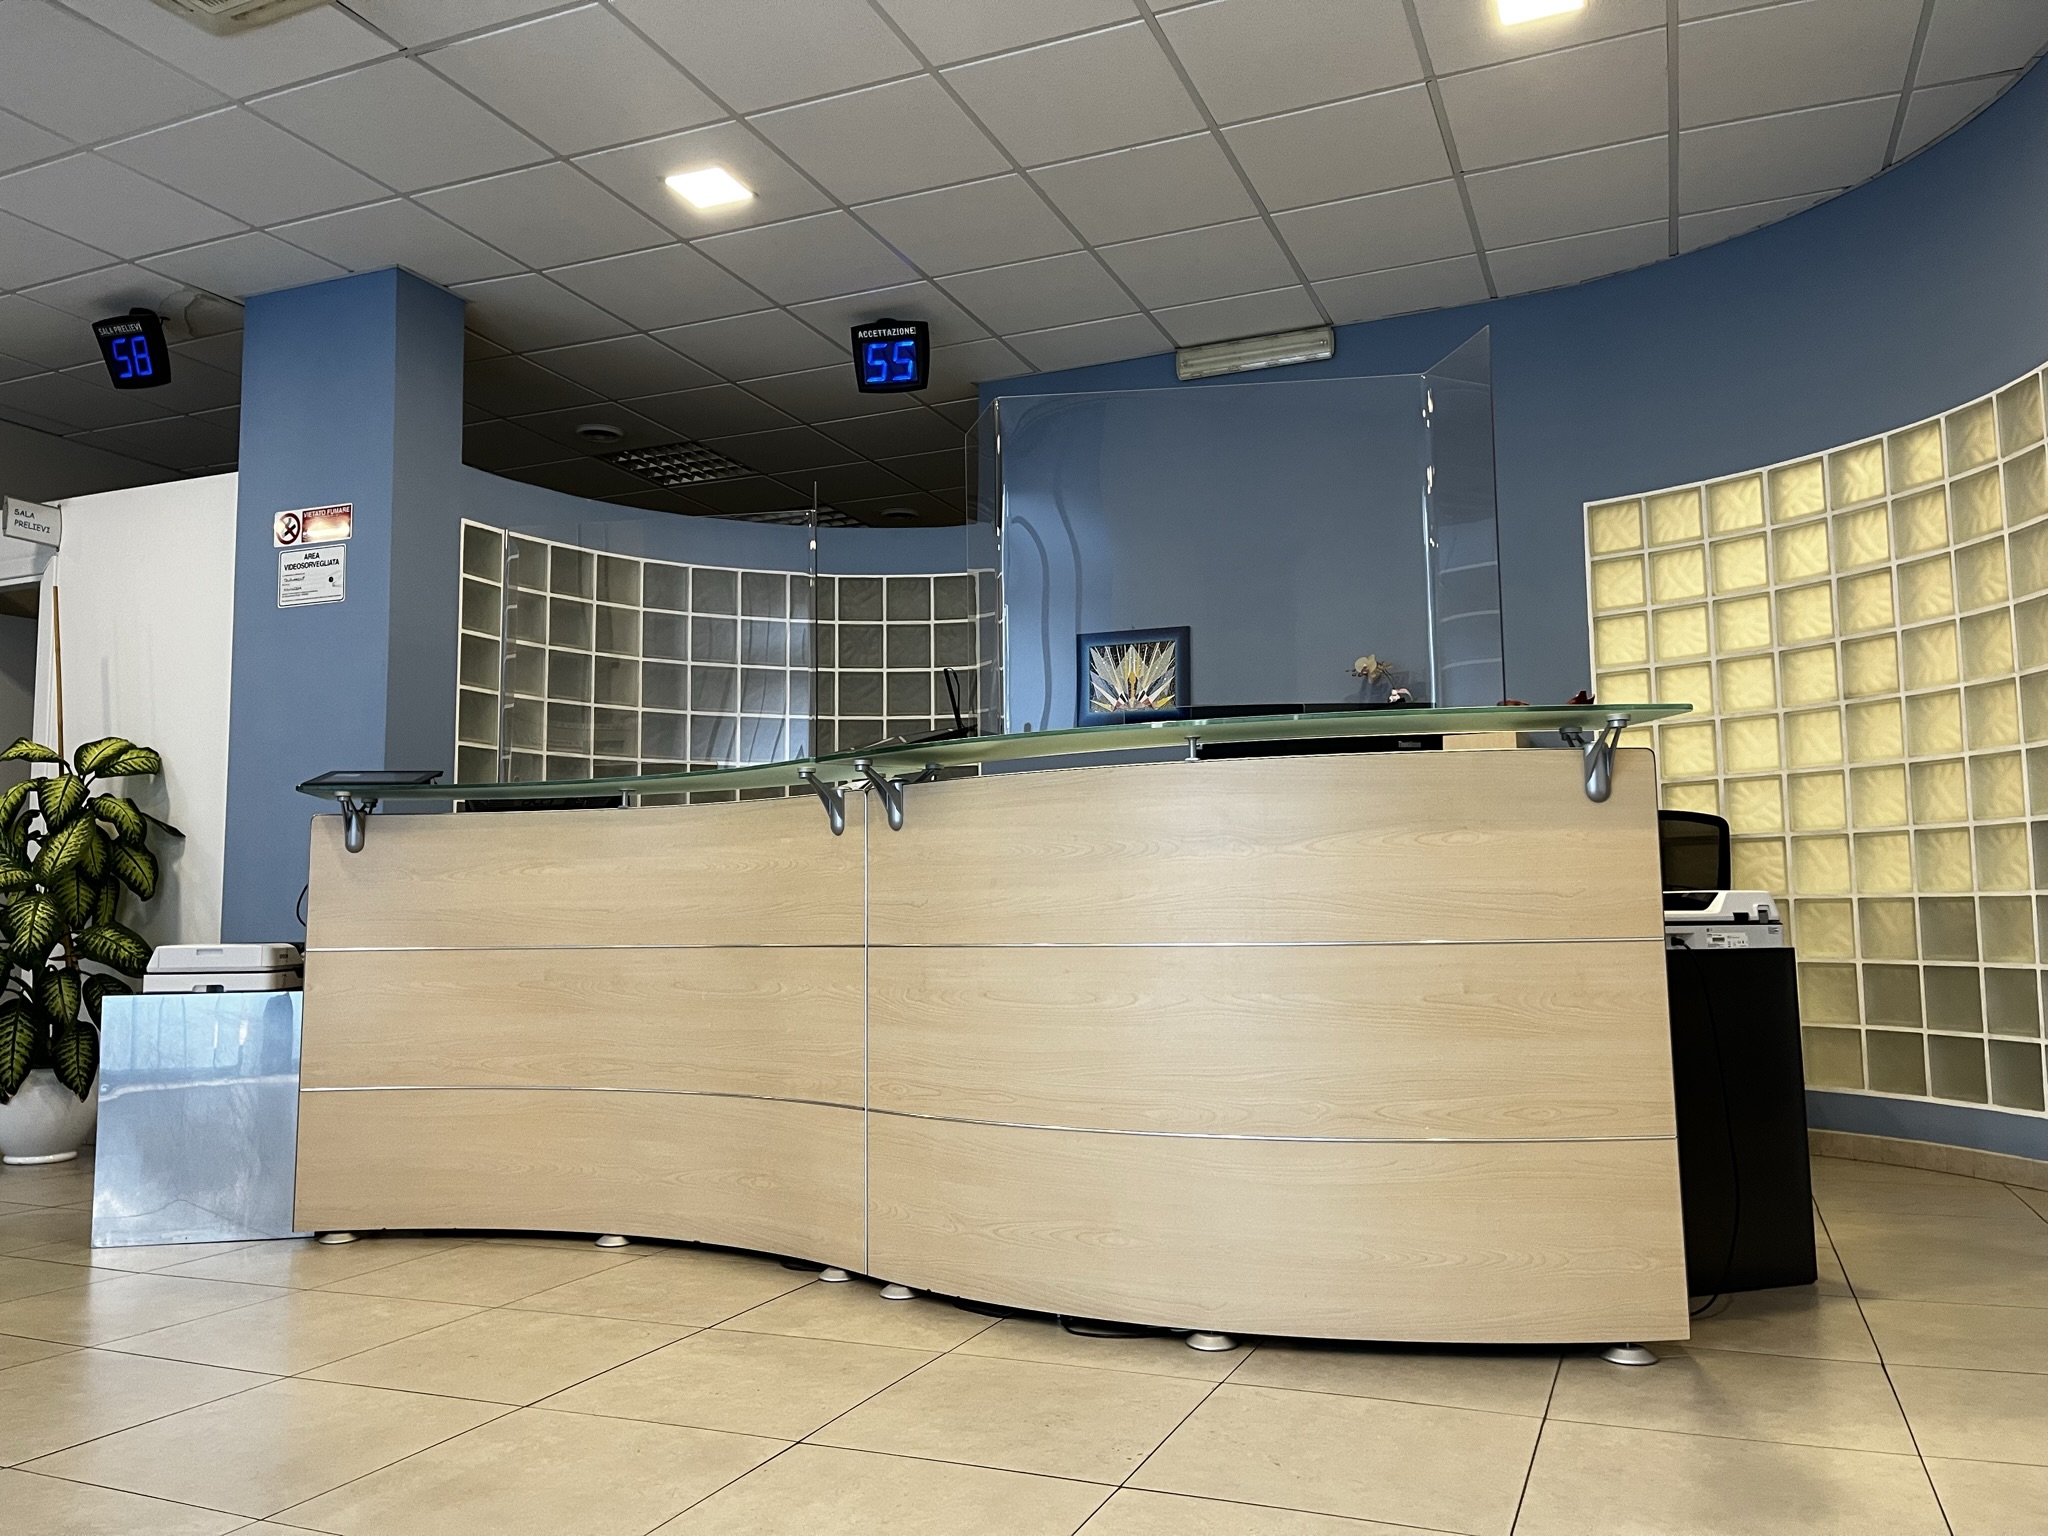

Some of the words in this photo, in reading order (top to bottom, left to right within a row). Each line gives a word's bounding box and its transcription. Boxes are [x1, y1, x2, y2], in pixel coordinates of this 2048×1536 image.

[98, 327, 114, 336] SALA
[858, 326, 916, 338] ACCETTAZIONE
[112, 335, 152, 378] 58
[866, 341, 915, 382] 55
[14, 508, 35, 519] SALA
[303, 509, 326, 518] VIETATO
[327, 506, 350, 516] FUMARE
[14, 519, 51, 534] PRELIEVI
[304, 552, 320, 560] AREA
[284, 559, 340, 571] VIDEOSORVEGLIATA
